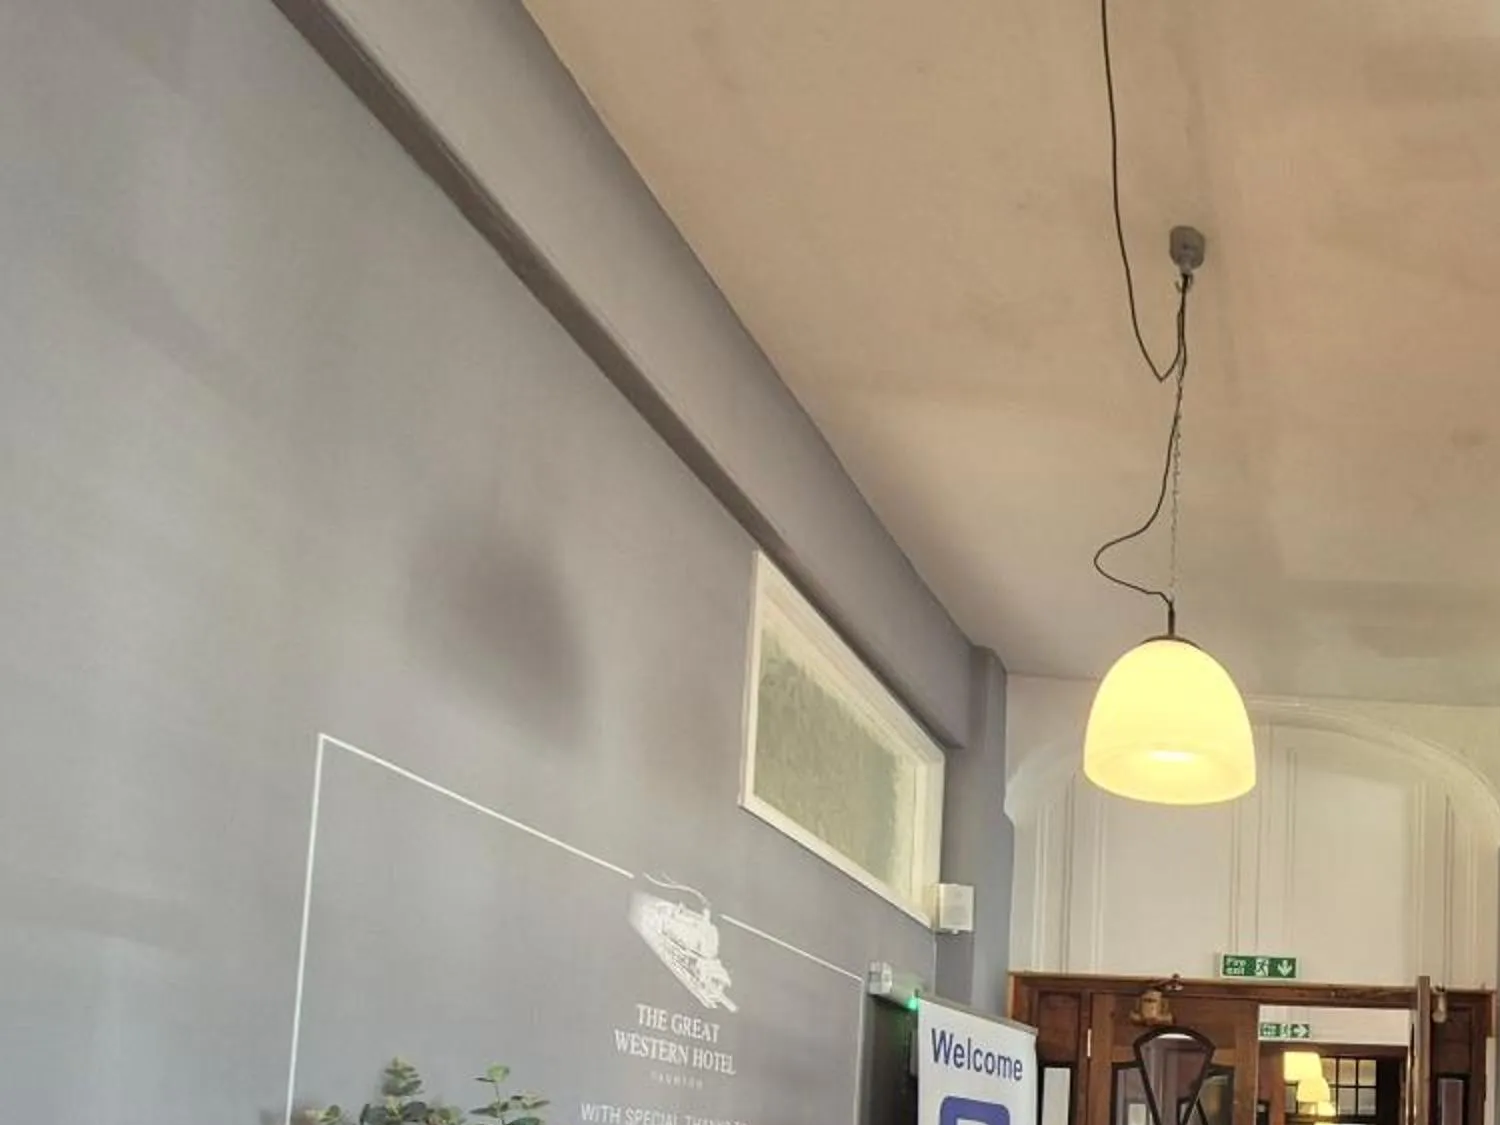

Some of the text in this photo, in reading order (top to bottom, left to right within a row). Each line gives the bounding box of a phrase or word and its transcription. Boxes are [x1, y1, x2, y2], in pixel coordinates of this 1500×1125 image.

[637, 1004, 720, 1043] THE GREAT
[614, 1029, 737, 1075] WESTERN HOTEL
[931, 1028, 1023, 1081] Welcome
[581, 1103, 621, 1125] WITH
